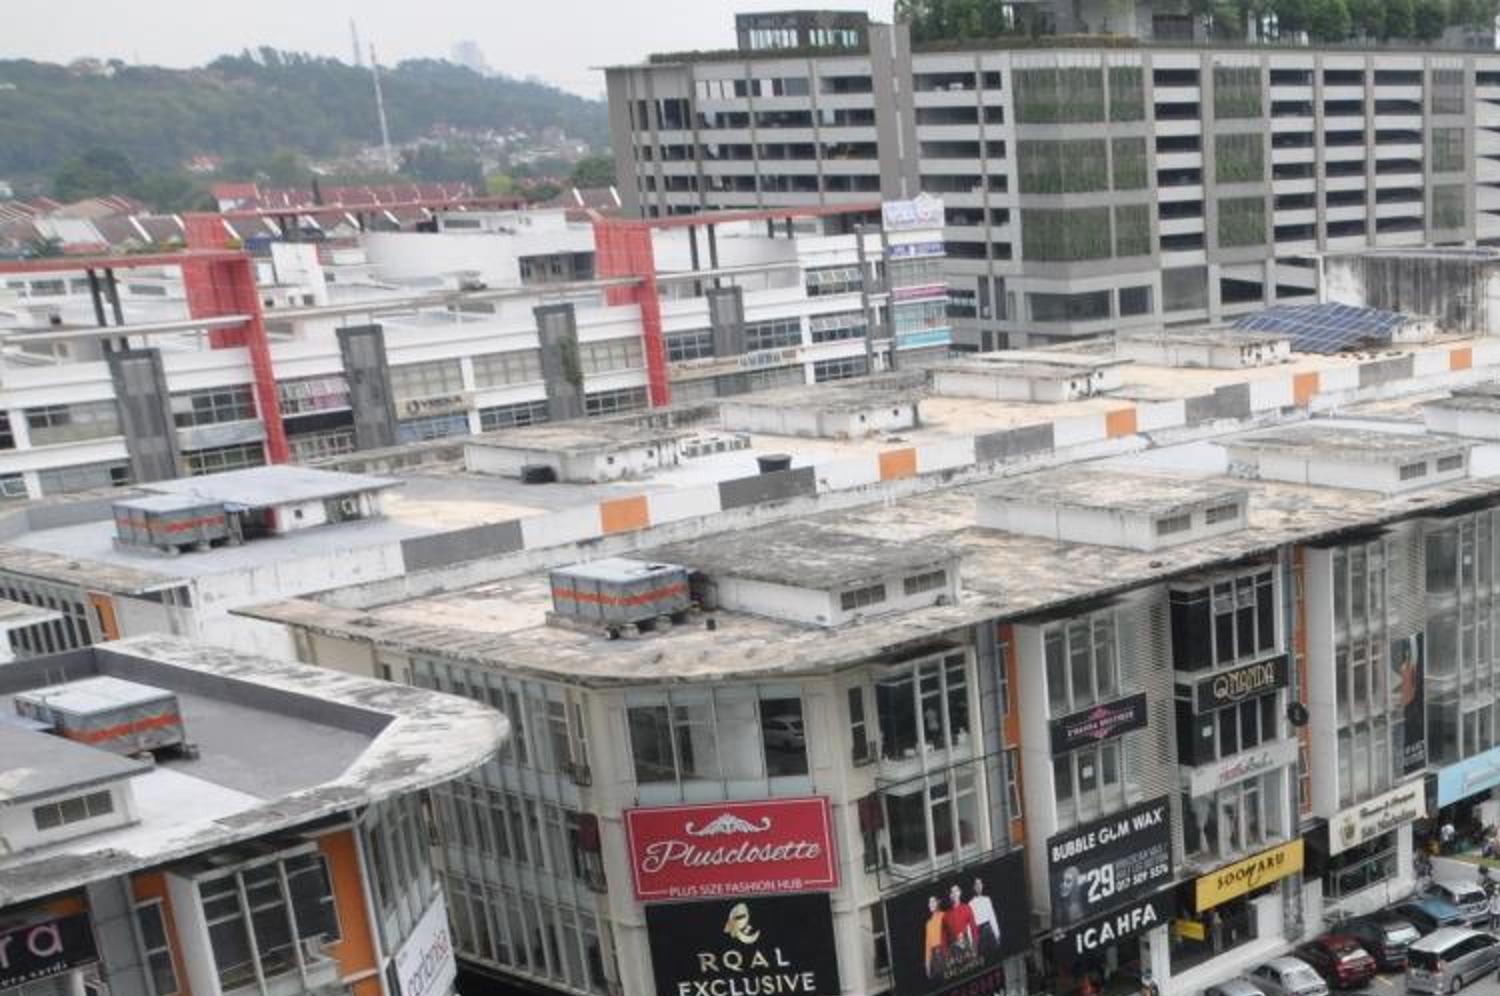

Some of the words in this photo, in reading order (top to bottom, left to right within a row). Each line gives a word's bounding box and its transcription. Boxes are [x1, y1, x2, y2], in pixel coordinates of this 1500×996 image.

[1052, 832, 1097, 863] BUBBLE
[1132, 808, 1163, 832] WAX
[642, 840, 821, 873] Plusclosette
[669, 885, 698, 897] PLUS
[701, 885, 723, 896] SIZE
[726, 882, 777, 894] FASHION
[779, 880, 803, 890] HUB
[1087, 863, 1115, 903] 29
[1076, 903, 1158, 954] ICAHFA
